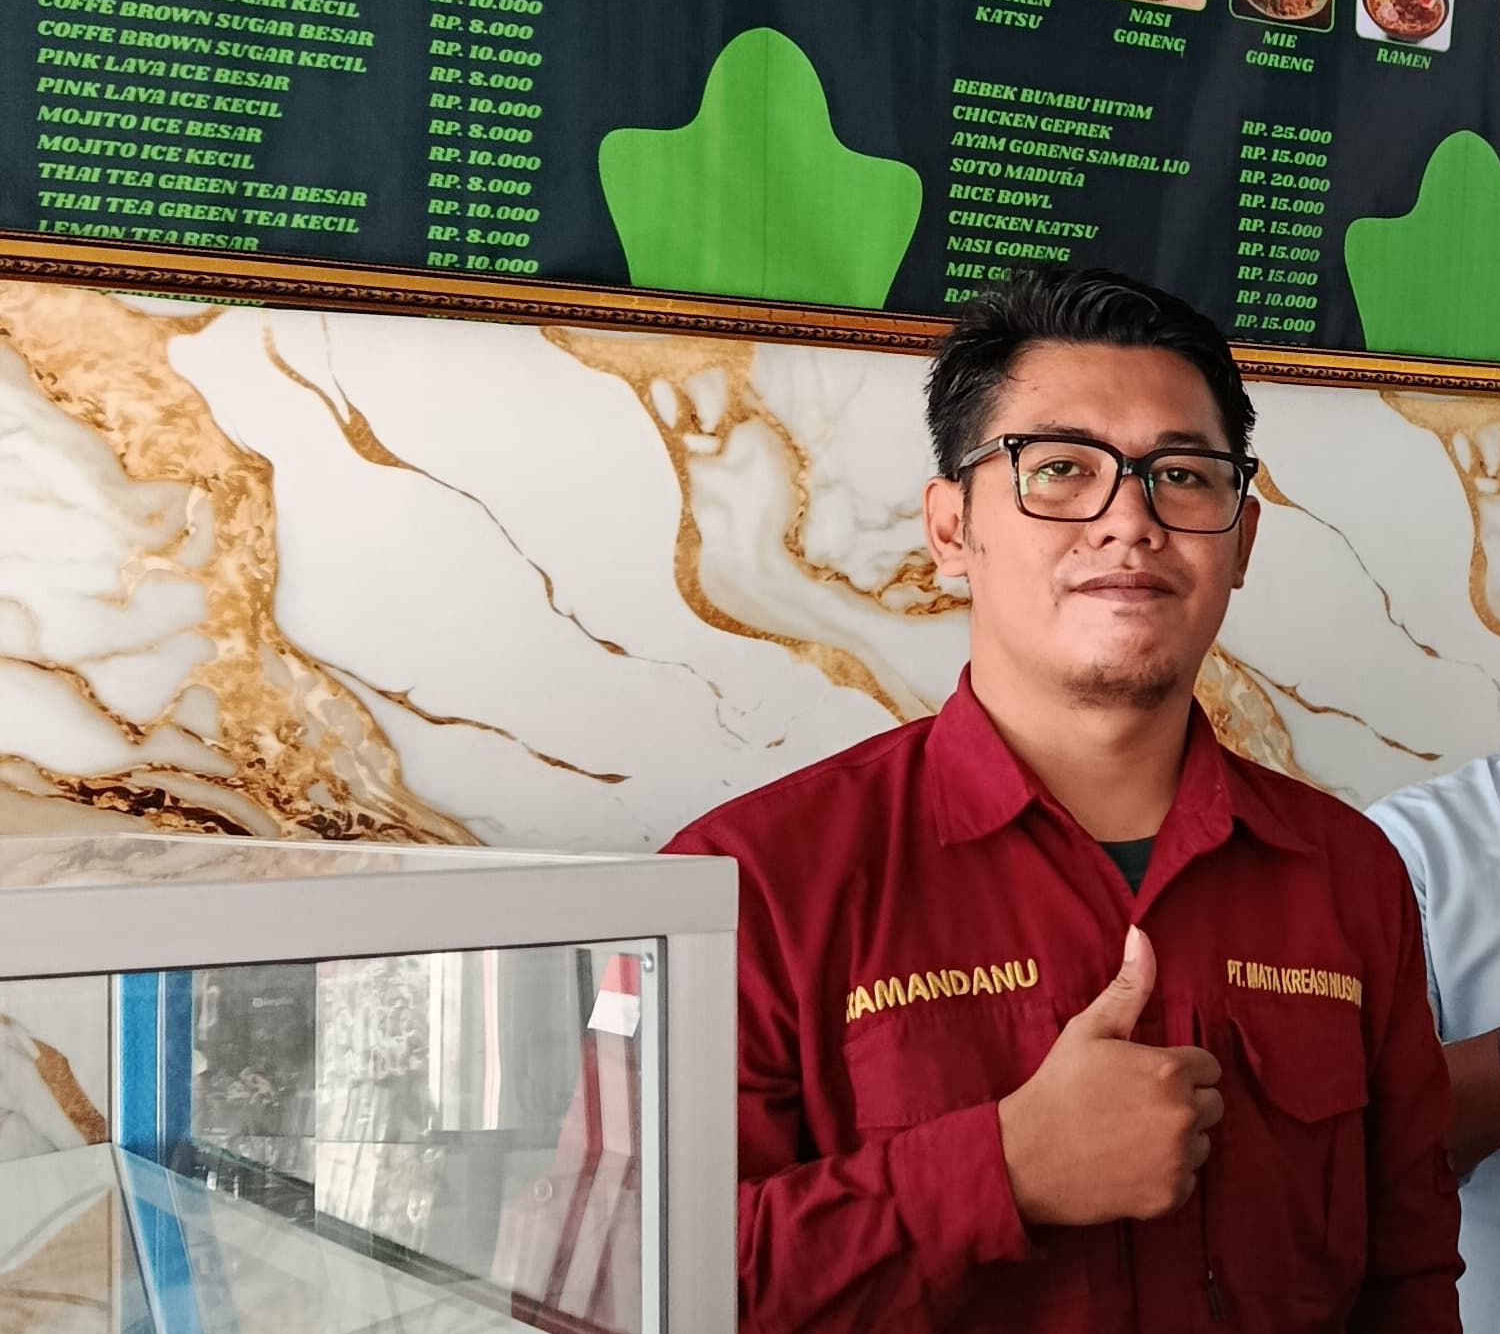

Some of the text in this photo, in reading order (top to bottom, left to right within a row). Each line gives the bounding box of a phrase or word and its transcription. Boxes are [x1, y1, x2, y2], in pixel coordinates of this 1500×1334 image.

[119, 2, 213, 25] BROWN
[215, 14, 294, 37] SUGAR
[298, 24, 374, 46] BESAR
[430, 14, 533, 39] RP. 8.000
[976, 6, 1043, 28] KATSU
[1129, 9, 1171, 27] NASI
[38, 20, 366, 72] COFFE BROWN SUGAR KECIL
[1114, 29, 1186, 52] GORENG
[1263, 31, 1297, 48] MIE
[429, 40, 542, 66] RP. 10.000
[1246, 50, 1314, 72] GORENG
[1377, 48, 1431, 69] RAMEN
[37, 48, 290, 91] PINK LAVA ICE BESAR
[37, 77, 282, 117] PINK LAVA ICE KECIL
[430, 93, 542, 118] RP. 10.000
[953, 79, 1153, 119] BEBEK BUMBU HITAM
[37, 106, 262, 142] MOJITO ICE BESAR
[429, 120, 532, 143] RP. 8.000
[953, 105, 1113, 139] CHICKEN GEPREK
[1242, 121, 1332, 144] RP. 25.000
[37, 134, 254, 169] MOJITO ICE KECIL
[951, 132, 1190, 174] AYAM GORENG SAMBAL IJO
[1241, 145, 1327, 167] RP. 15.000
[38, 163, 367, 206] THAI TEA GREEN TEA BESAR
[950, 158, 1085, 187] SOTO MADURA
[1240, 170, 1330, 192] RP. 20.000
[949, 184, 1052, 208] RICE BOWL
[428, 199, 539, 222] RP. 10.000
[38, 220, 259, 251] LEMON TEA BESAR
[427, 226, 530, 247] RP. 8.000
[949, 211, 1099, 239] CHICKEN KATSU
[1239, 218, 1322, 238] RP. 15.000
[947, 236, 1070, 261] NASI GORENG
[946, 262, 985, 279] MIE
[1236, 290, 1317, 309] RP. 10.000
[1235, 314, 1315, 332] RP. 15.000
[1227, 959, 1245, 987] PT.
[1246, 962, 1281, 994] MATA
[1281, 967, 1328, 997] KREASI
